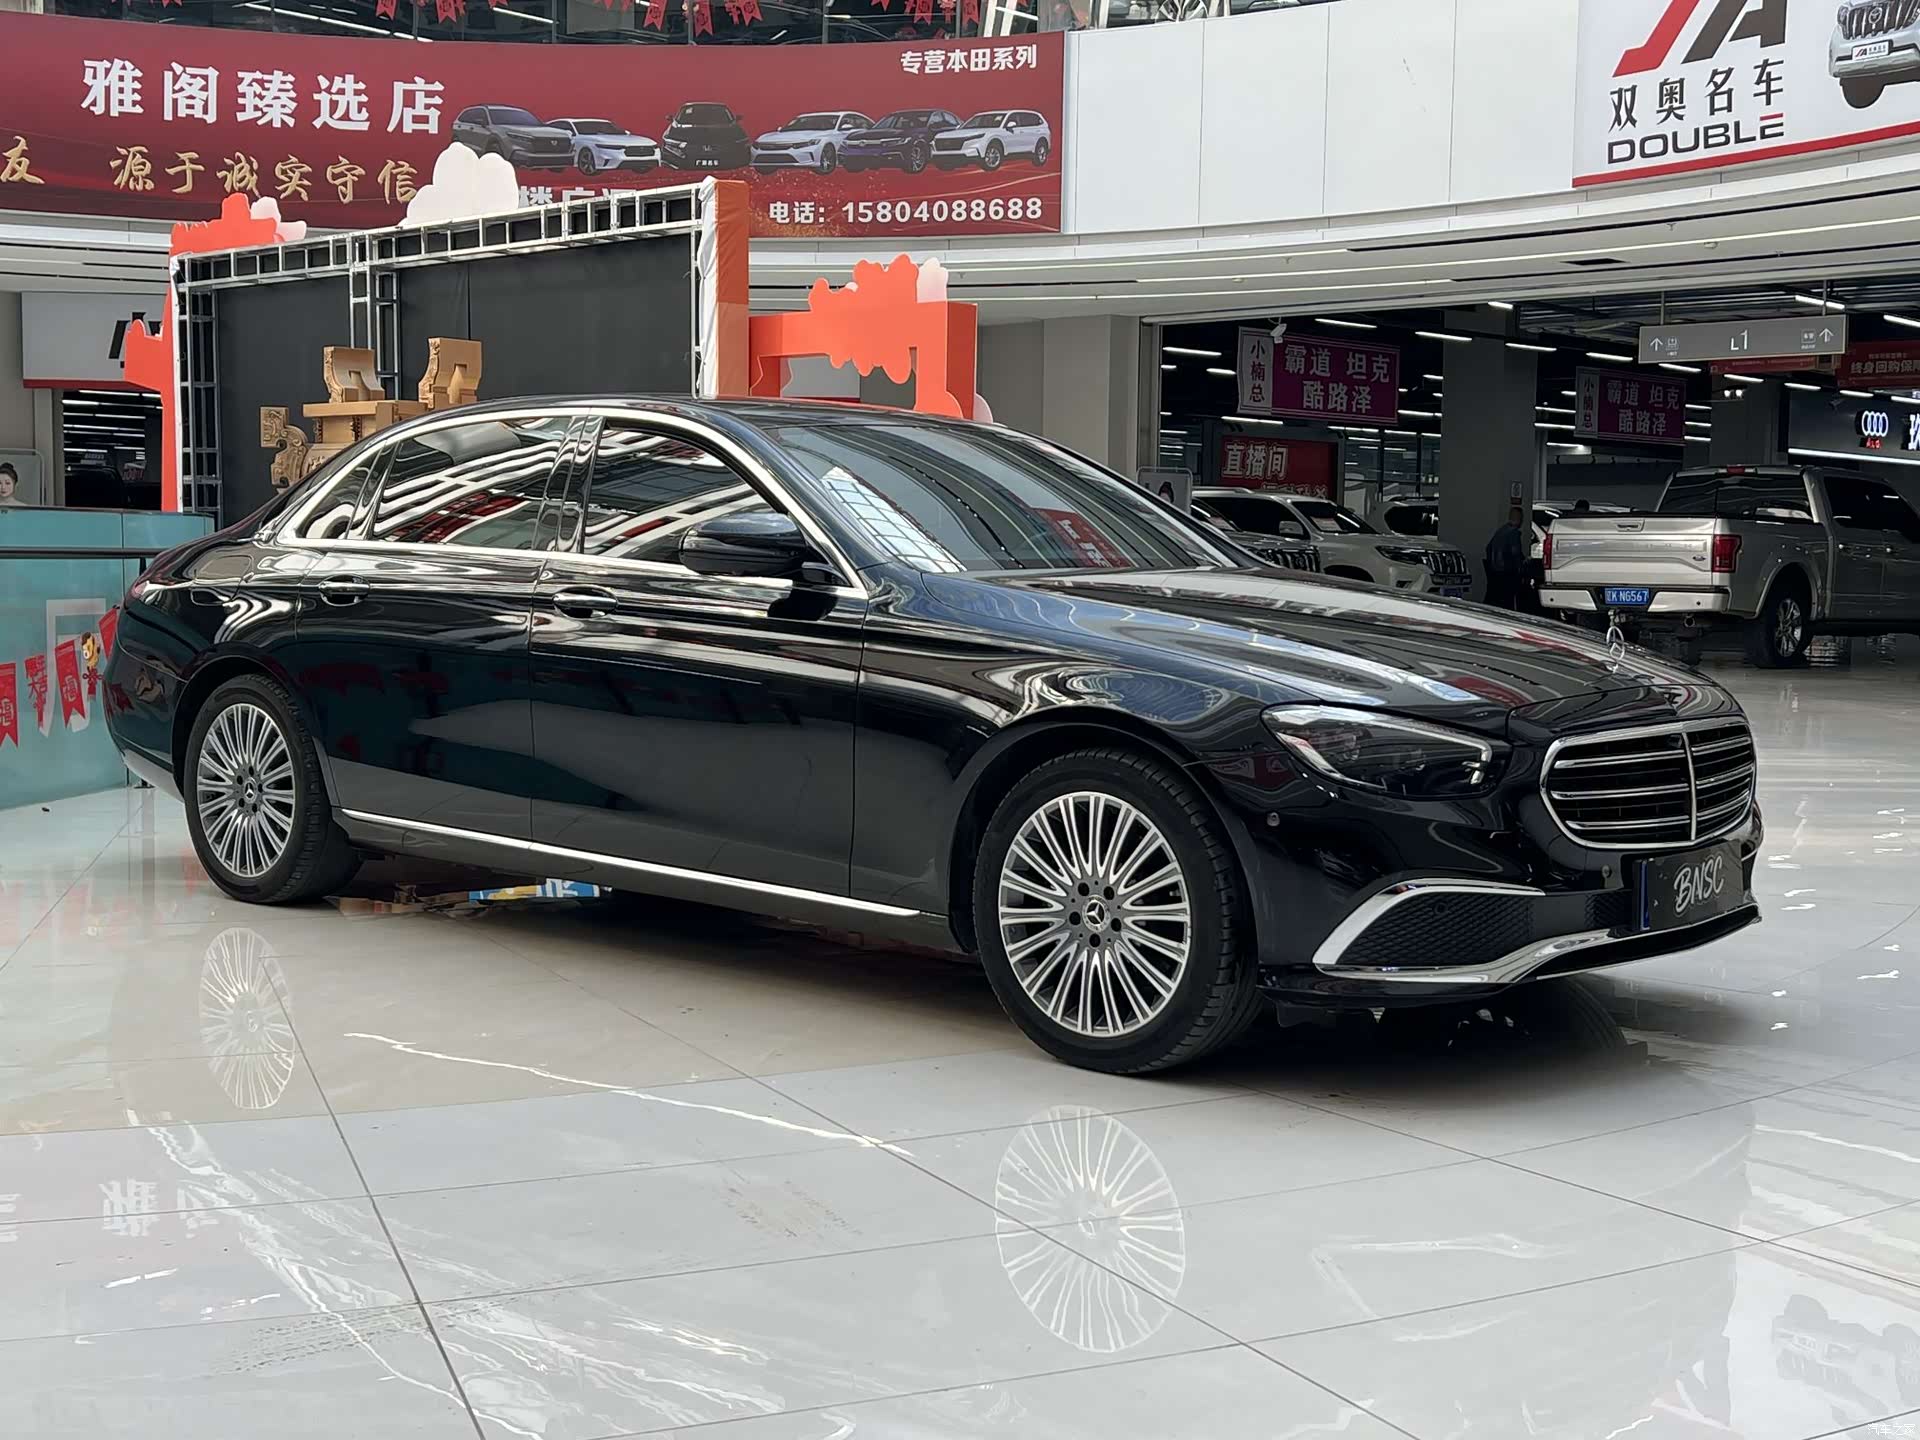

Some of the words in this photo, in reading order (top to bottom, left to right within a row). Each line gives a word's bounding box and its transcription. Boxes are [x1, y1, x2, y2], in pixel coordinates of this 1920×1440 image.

[900, 44, 1037, 75] 专营本田系列
[80, 57, 445, 136] 雅阁臻选店
[1608, 58, 1785, 133] 双奥名车
[1607, 113, 1785, 165] DOUBLE
[110, 144, 418, 205] 源于诚实守信
[1730, 329, 1749, 351] L1
[1249, 340, 1265, 403] 小楠总
[1284, 344, 1332, 378] 霸道
[1346, 351, 1391, 383] 坦克
[1302, 380, 1372, 414] 酷路泽
[1607, 379, 1640, 406] 霸道
[1648, 384, 1681, 410] 坦克
[1617, 408, 1667, 436] 酷路泽
[1223, 441, 1288, 480] 直播间
[1673, 854, 1725, 914] BNSC
